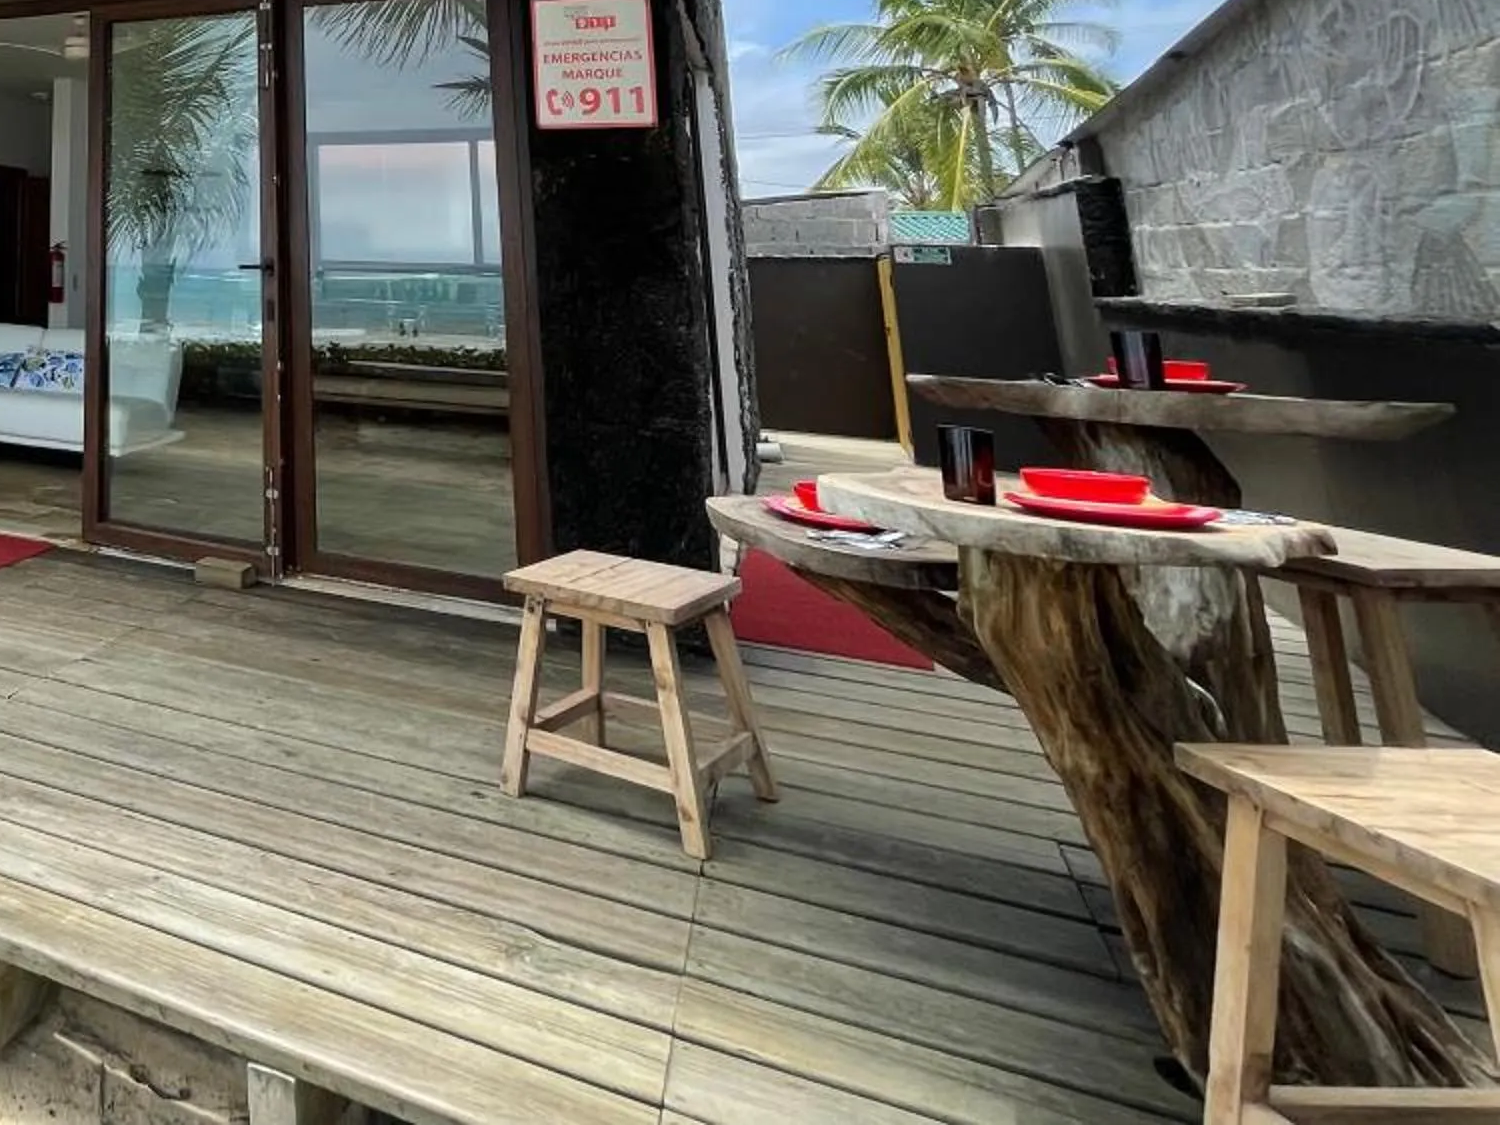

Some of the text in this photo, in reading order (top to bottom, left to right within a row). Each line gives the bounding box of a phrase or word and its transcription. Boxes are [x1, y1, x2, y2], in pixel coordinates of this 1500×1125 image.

[543, 50, 643, 65] EMERGENCIAS
[561, 68, 624, 80] MARQUE
[579, 85, 645, 115] 911
